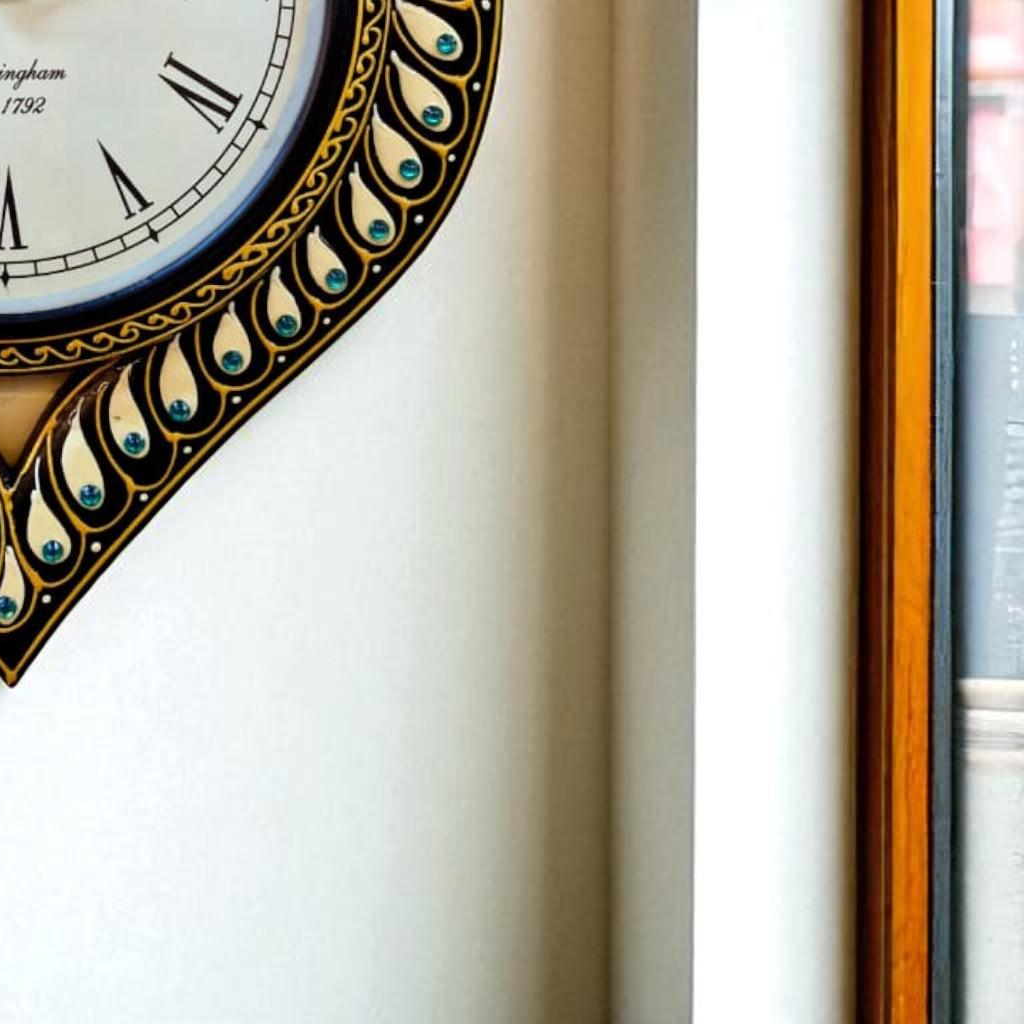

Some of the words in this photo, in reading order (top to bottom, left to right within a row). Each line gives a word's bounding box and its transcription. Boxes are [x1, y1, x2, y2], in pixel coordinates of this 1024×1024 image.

[0, 96, 47, 115] 1792
[157, 52, 243, 134] IV
[97, 139, 154, 220] V
